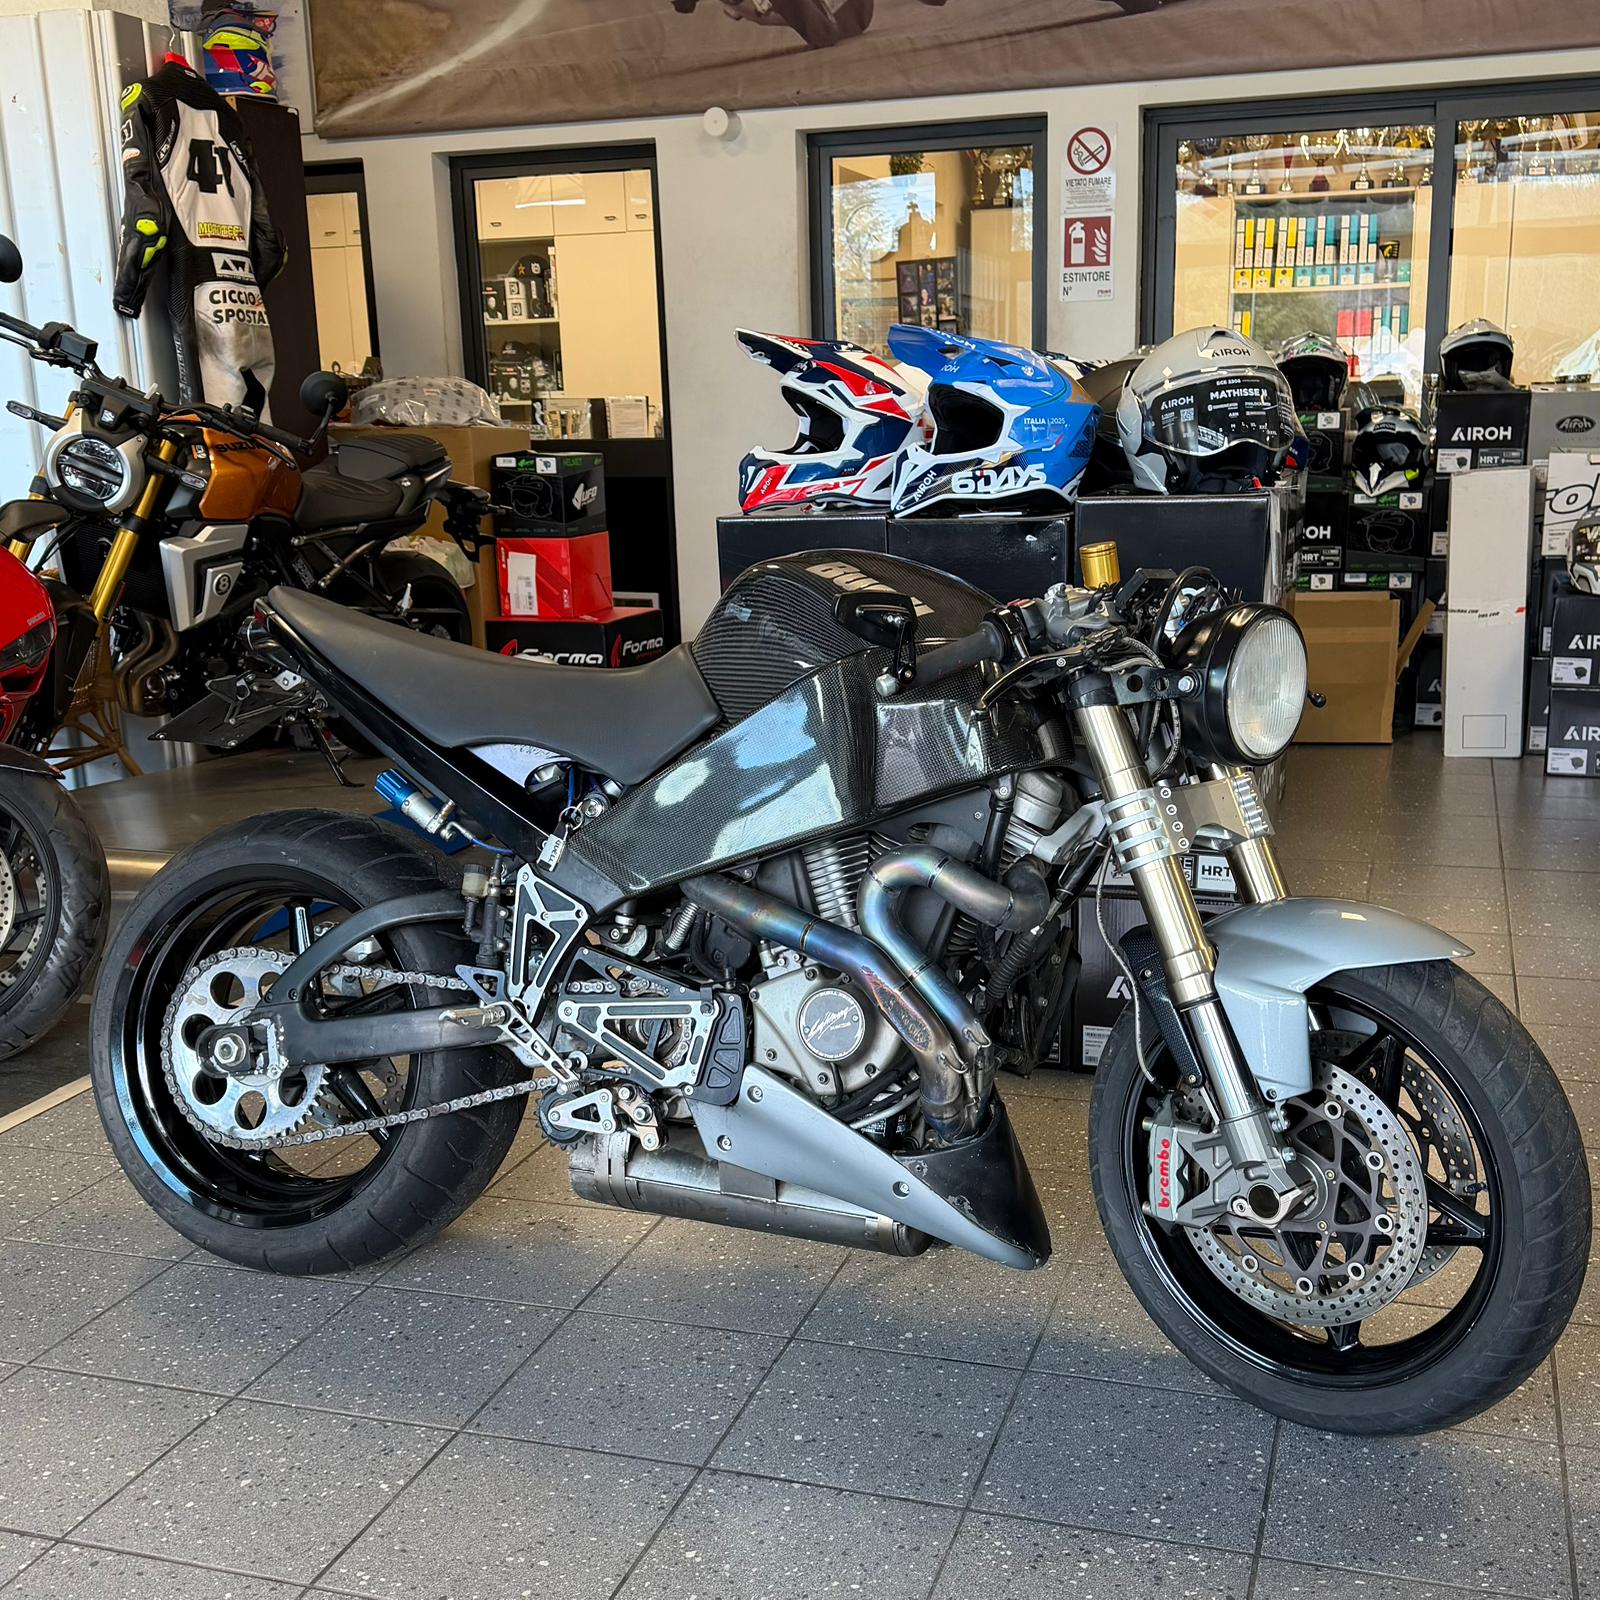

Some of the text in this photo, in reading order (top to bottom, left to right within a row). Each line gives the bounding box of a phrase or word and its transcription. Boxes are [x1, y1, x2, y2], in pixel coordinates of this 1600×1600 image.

[1065, 177, 1112, 187] VIETATO FUMARE
[1063, 271, 1111, 283] ESTINTORE
[209, 289, 256, 305] CICCIO
[1211, 348, 1251, 358] AIROH
[1210, 388, 1260, 400] MATHISSE
[1160, 395, 1194, 410] AIROH
[1559, 417, 1592, 429] Airoh
[1451, 426, 1513, 441] AIROH
[1480, 456, 1500, 465] HRT
[913, 470, 938, 501] AIROH
[1302, 525, 1332, 540] OH
[622, 636, 664, 656] Forma
[1201, 865, 1231, 877] HRT
[1157, 1138, 1172, 1210] brembo
